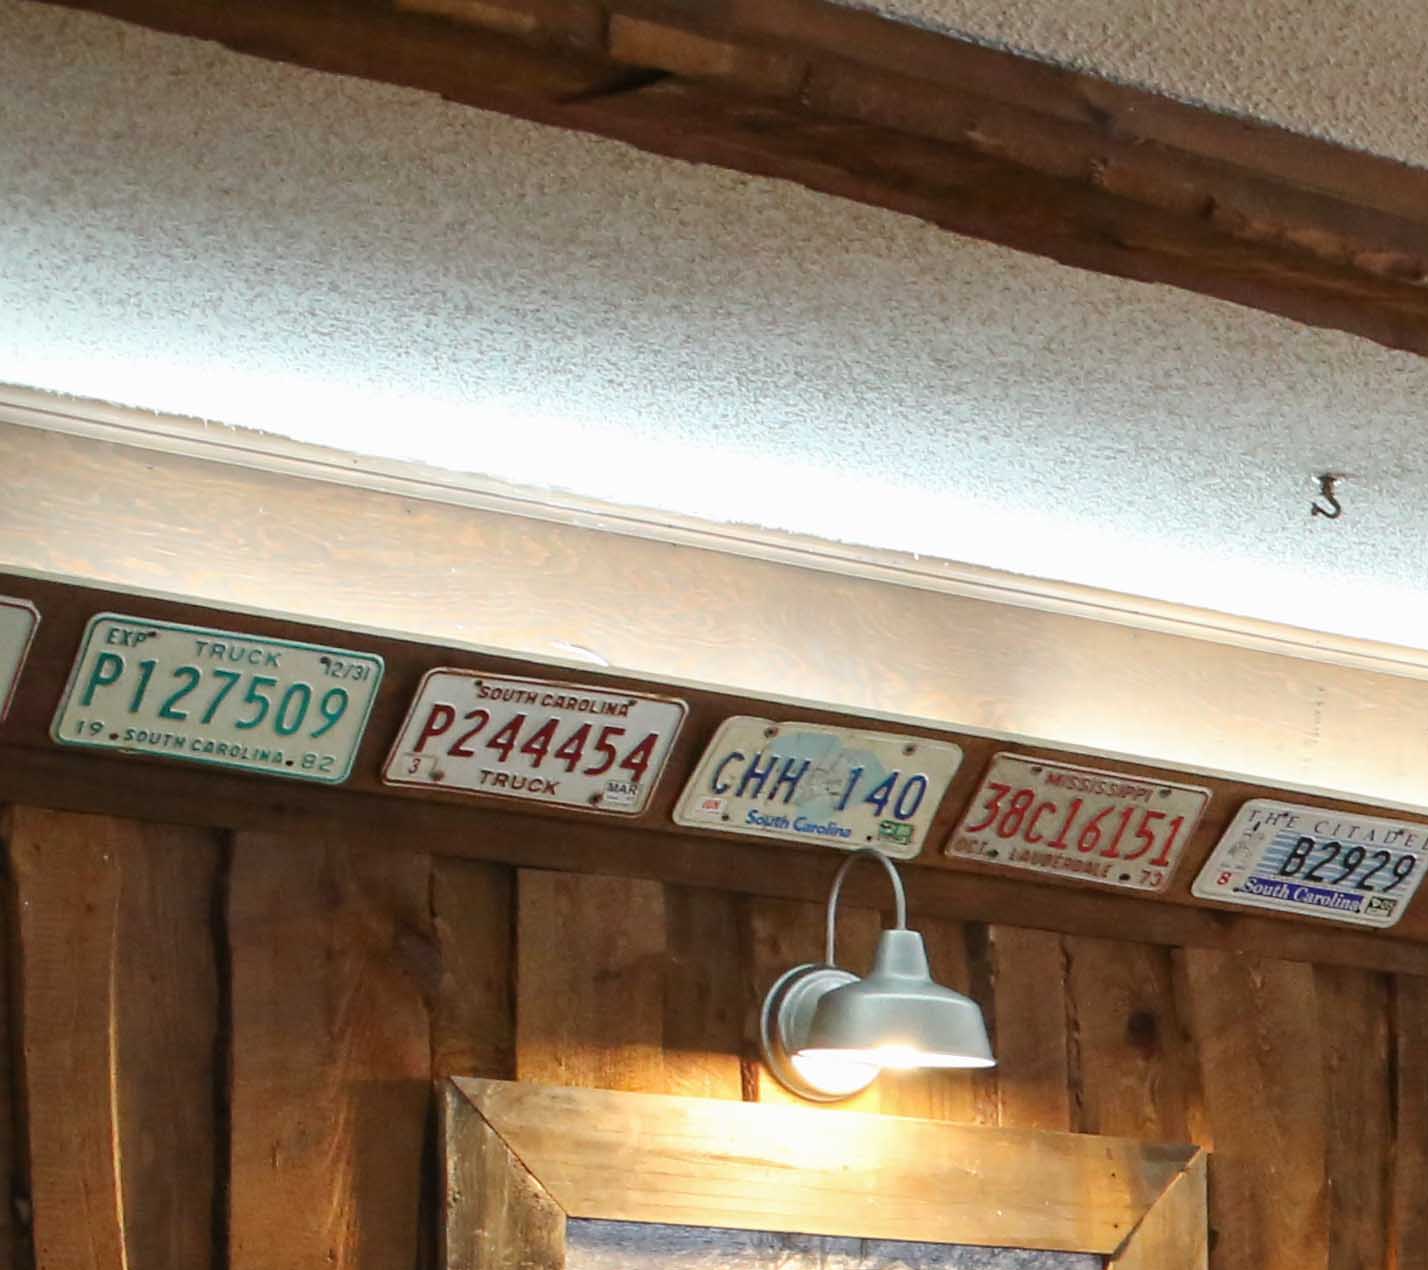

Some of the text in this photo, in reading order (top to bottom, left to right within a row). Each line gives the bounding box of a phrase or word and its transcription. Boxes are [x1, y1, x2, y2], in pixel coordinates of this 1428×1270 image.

[107, 628, 147, 647] EXP
[195, 641, 281, 667] TRUCK
[79, 652, 349, 739] P127509
[477, 686, 629, 717] SOUTH CAROLINA
[76, 721, 336, 773] 19 SOUTH CAROLINA 82
[414, 704, 658, 782] P244454
[407, 758, 421, 774] 3
[480, 770, 560, 795] TRUCK
[606, 782, 637, 795] MAR
[712, 751, 929, 820] CHH 140
[1044, 774, 1154, 800] MISSISSIPPI
[746, 810, 852, 838] South Carolina
[965, 782, 1185, 867] 38C16151
[1250, 810, 1300, 828] THE
[1009, 849, 1112, 878] LAUDERDALE
[1139, 871, 1164, 887] 73
[1217, 872, 1232, 885] 8
[1278, 836, 1417, 893] B2929
[1241, 878, 1290, 900] South
[1293, 888, 1362, 911] Carolina
